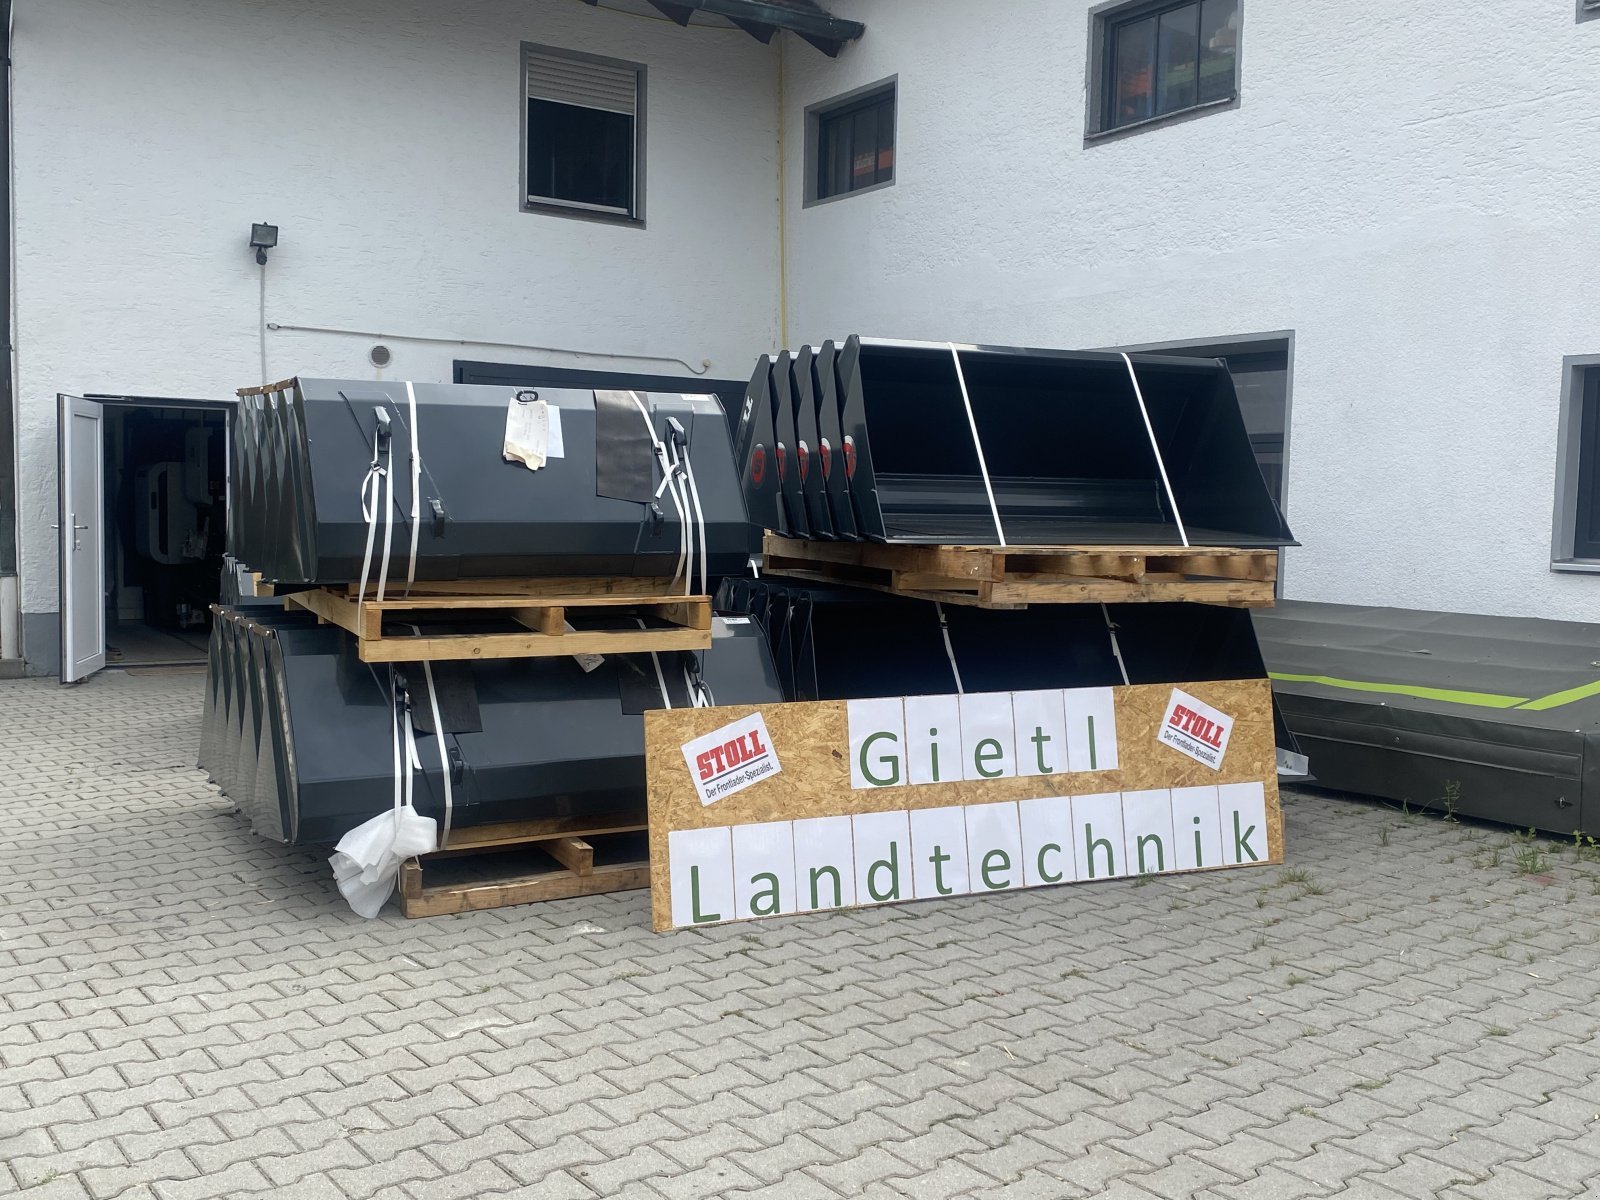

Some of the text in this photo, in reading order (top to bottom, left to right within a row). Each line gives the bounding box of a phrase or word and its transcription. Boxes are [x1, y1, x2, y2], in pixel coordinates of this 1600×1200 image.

[1163, 730, 1174, 741] Der
[1169, 703, 1224, 749] STOLL
[695, 729, 767, 781] STOLL
[859, 715, 1097, 787] Gietl
[705, 787, 717, 799] Der
[690, 810, 1259, 924] Landtechnik
